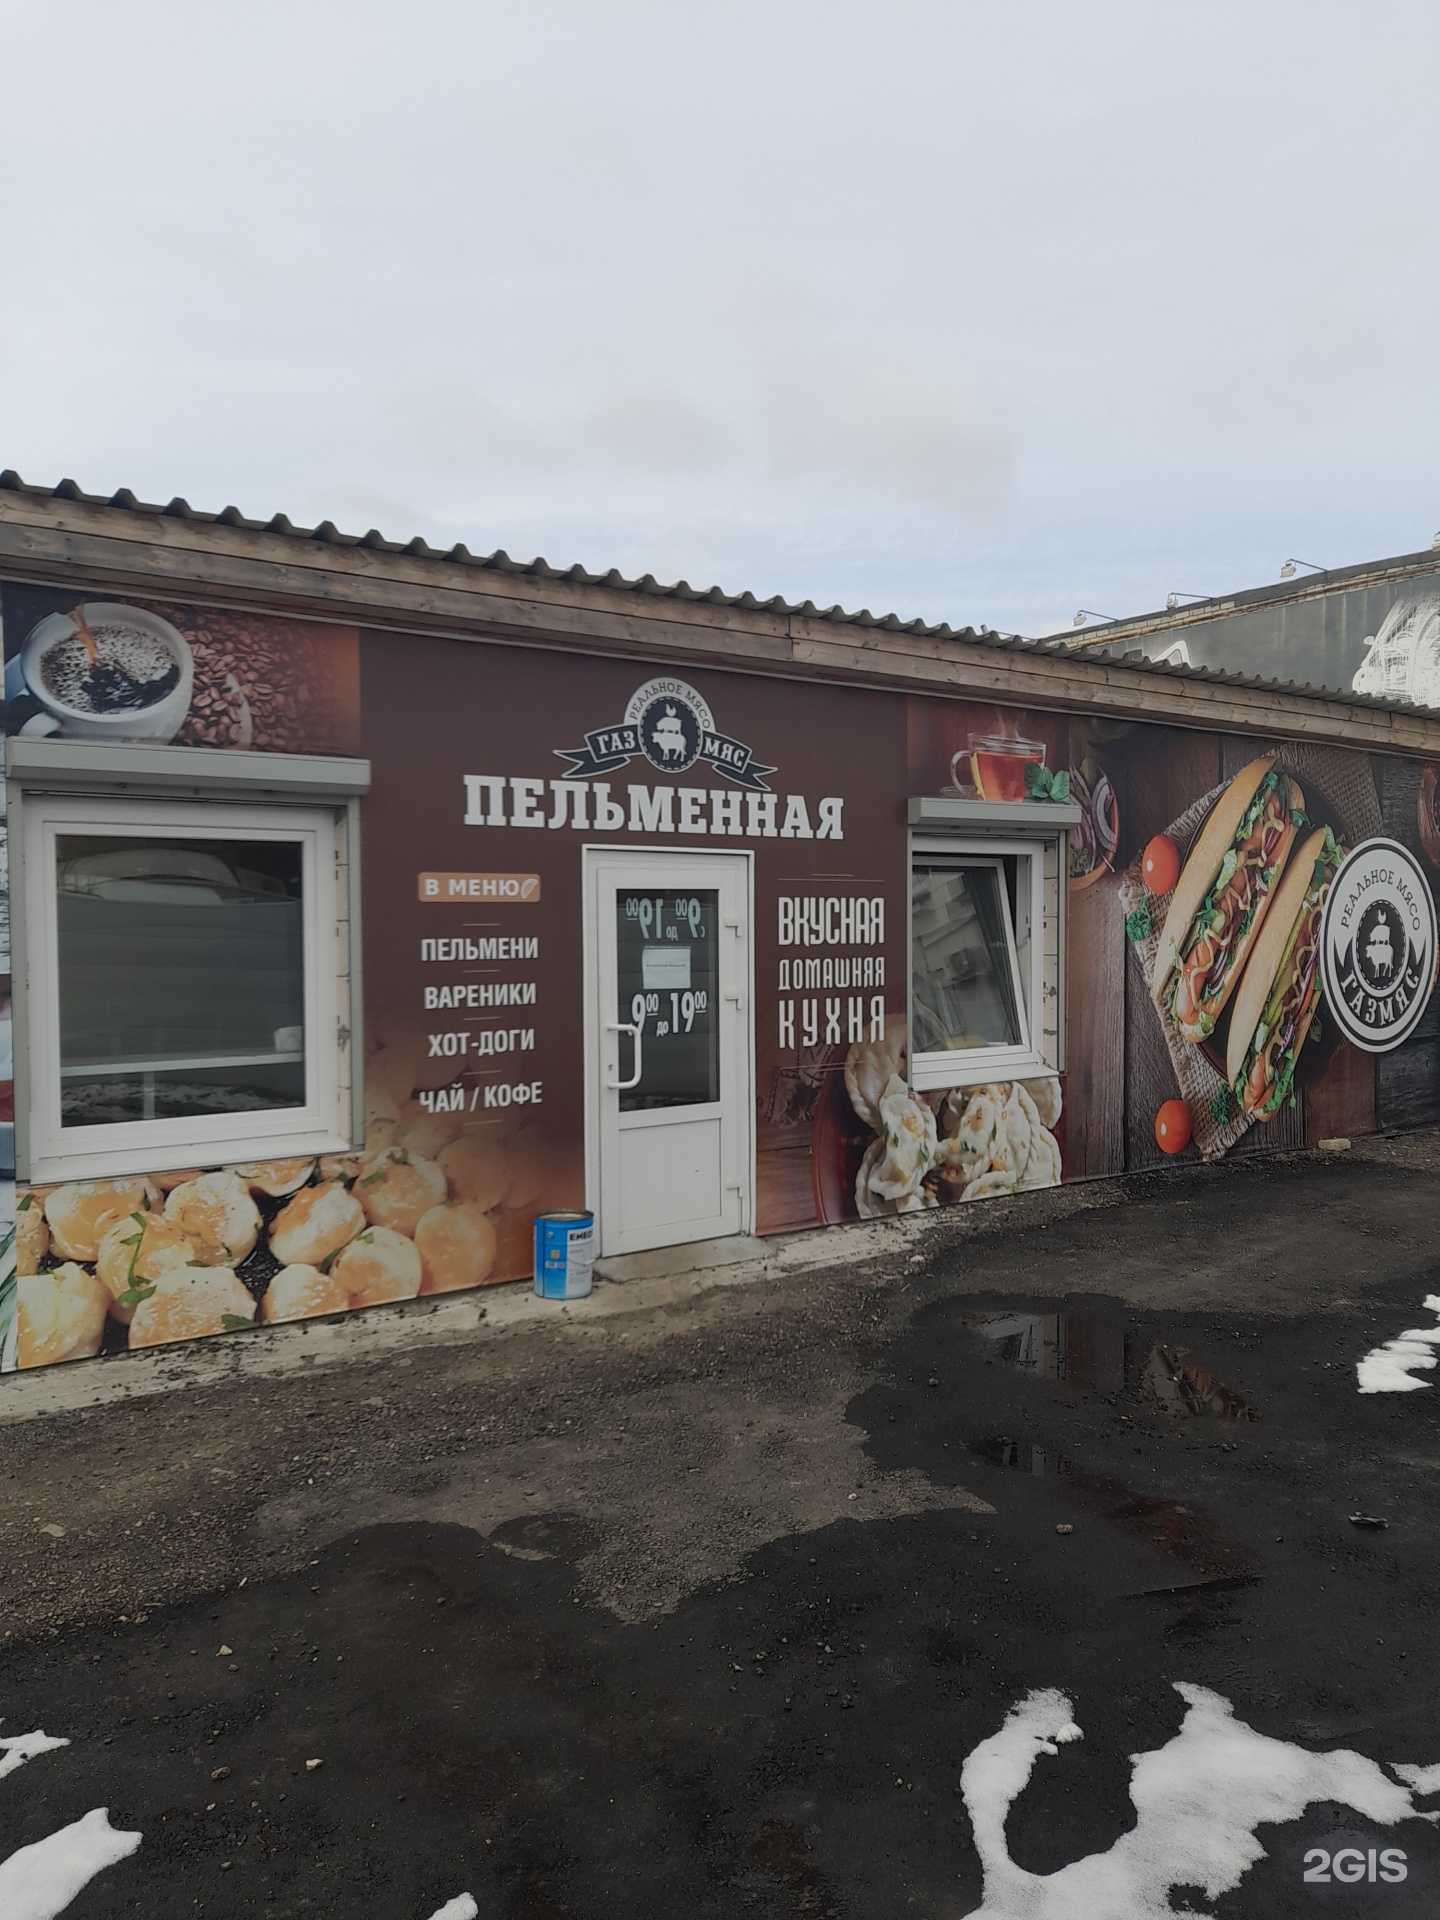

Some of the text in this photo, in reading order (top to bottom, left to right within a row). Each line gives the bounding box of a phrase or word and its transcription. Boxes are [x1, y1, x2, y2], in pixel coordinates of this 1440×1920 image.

[629, 682, 711, 729] РЕАЛЬНОЕ МЯСО
[596, 730, 745, 767] ГАЗ МЯС
[463, 774, 844, 840] ПЕЛЬМЕННАЯ
[425, 879, 520, 896] В МЕНЮ
[1341, 869, 1420, 931] РЕАЛЬНОЕ МЯСО
[778, 897, 885, 946] ВКУСНАЯ
[421, 937, 538, 961] ПЕЛЬМЕНИ
[778, 957, 885, 990] ДОМАШНЯЯ
[424, 982, 536, 1009] ВАРЕНИКИ
[1341, 967, 1420, 1026] ГАЗМЯС
[656, 1021, 669, 1037] до
[778, 995, 885, 1049] КУХНЯ
[428, 1028, 535, 1057] ХОТ-ДОГИ
[419, 1083, 464, 1113] ЧАЙ
[484, 1081, 543, 1108] КОФЕ
